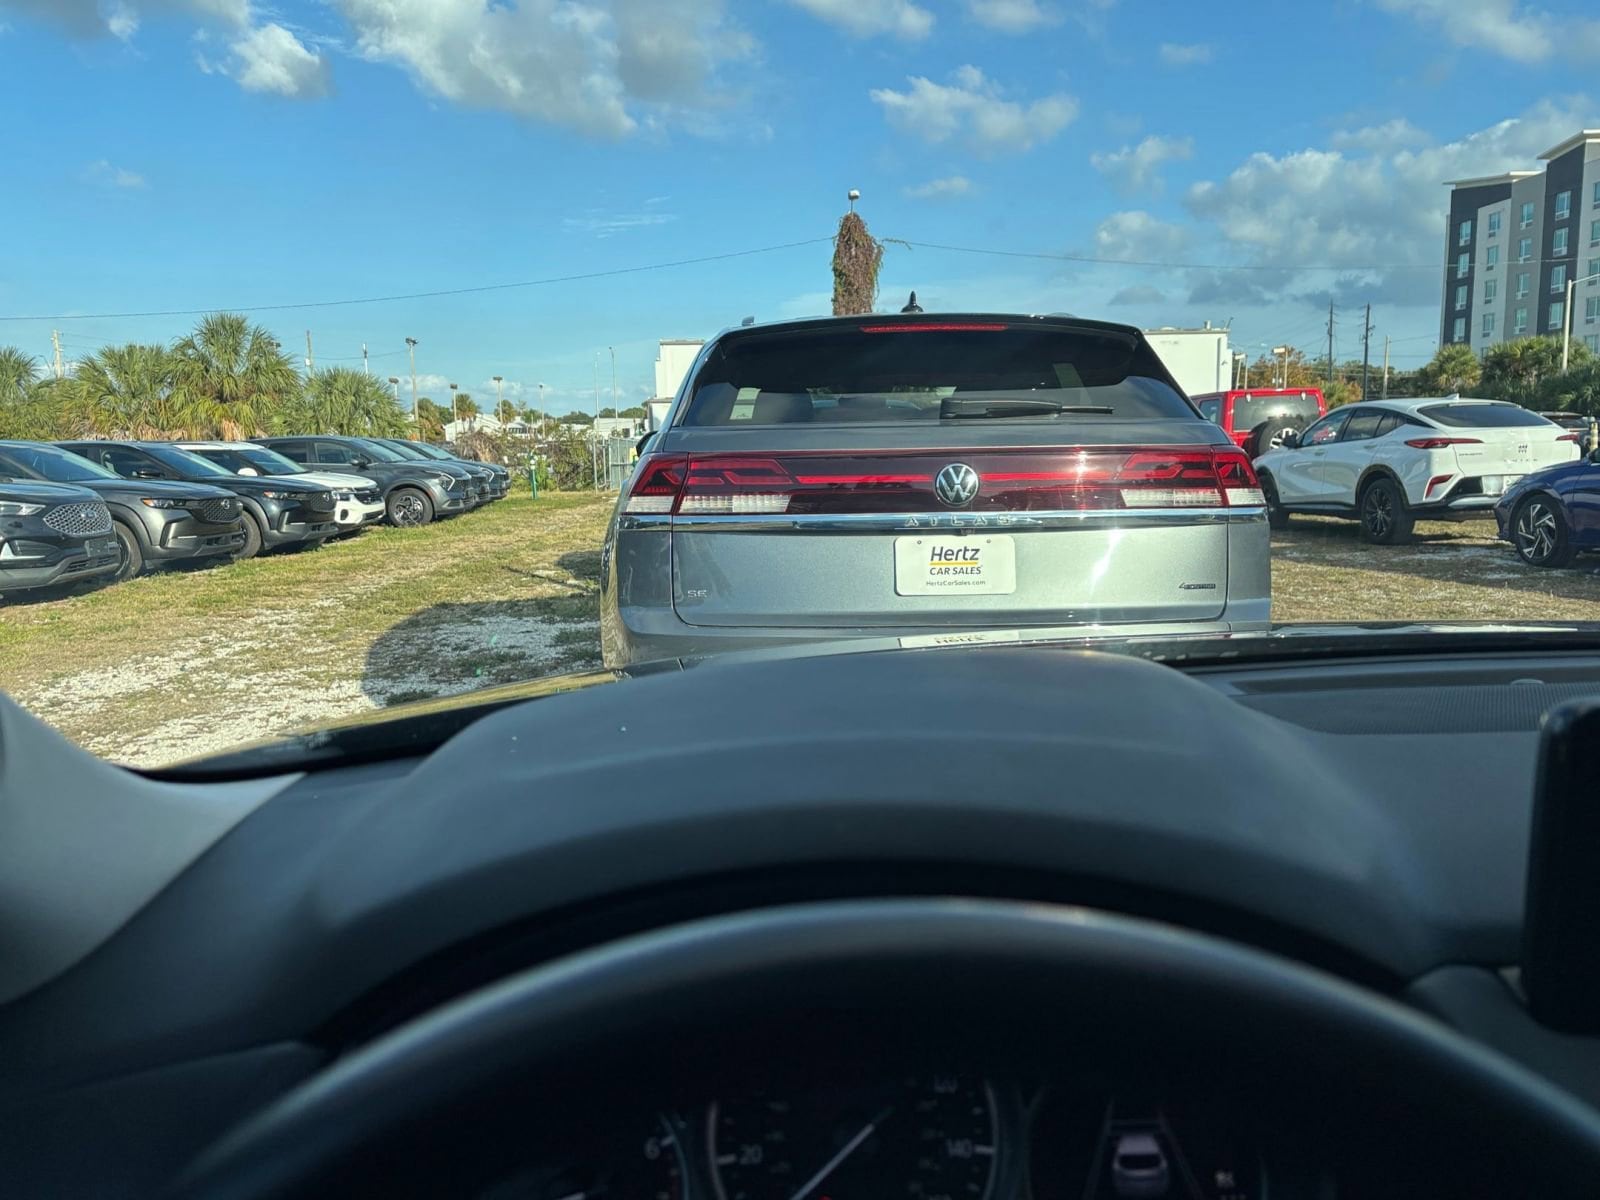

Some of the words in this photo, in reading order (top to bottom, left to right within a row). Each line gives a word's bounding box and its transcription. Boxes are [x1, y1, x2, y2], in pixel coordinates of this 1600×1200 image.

[904, 514, 1011, 526] ATLAS
[930, 545, 981, 561] Hertz
[929, 567, 950, 576] CAR
[952, 566, 982, 575] SALES
[739, 1144, 763, 1165] 20
